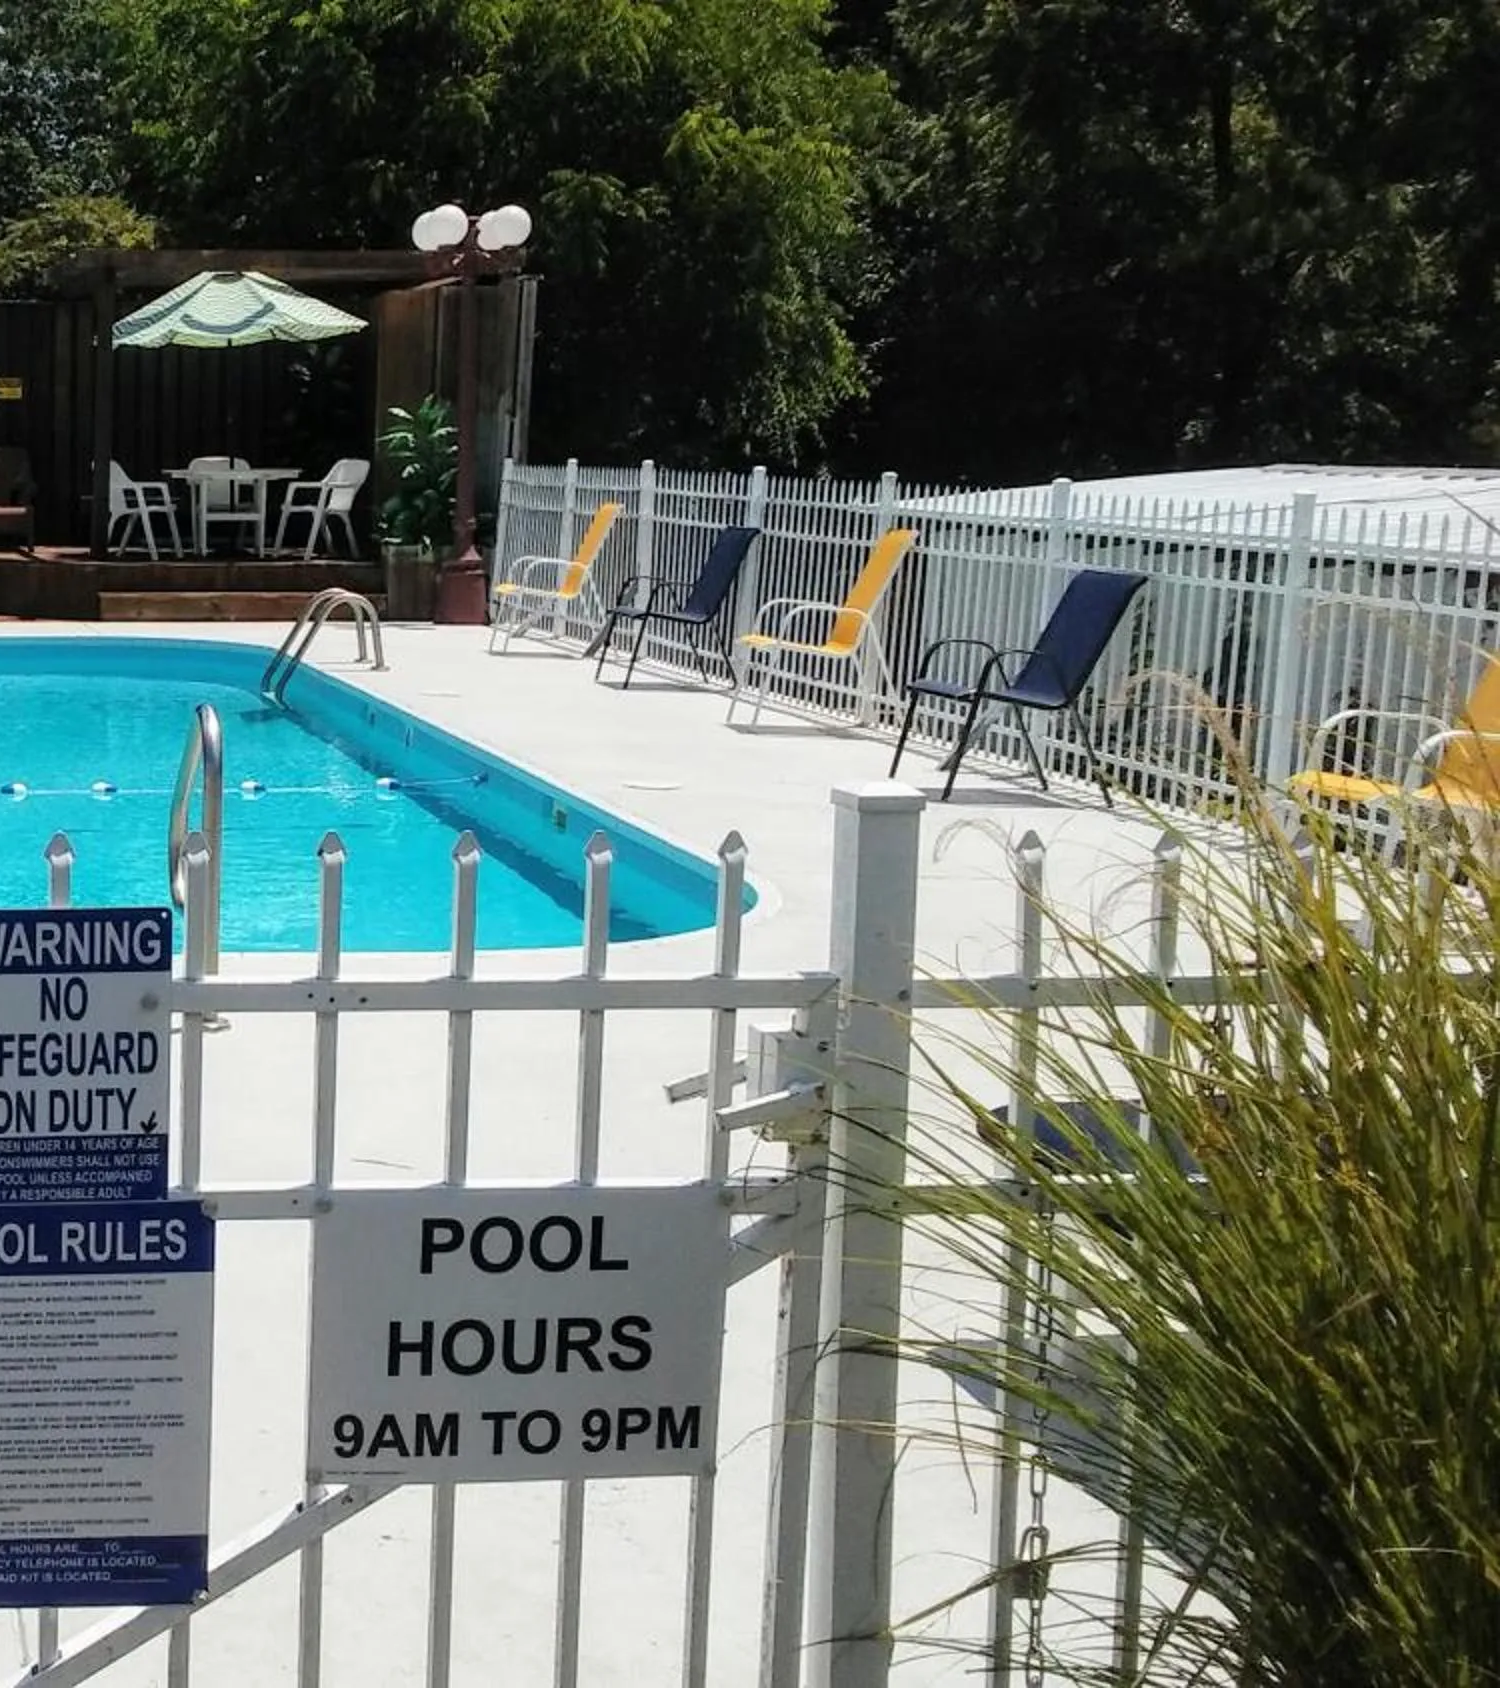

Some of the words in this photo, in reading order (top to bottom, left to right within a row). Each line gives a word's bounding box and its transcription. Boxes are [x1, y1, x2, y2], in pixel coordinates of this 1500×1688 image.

[40, 976, 88, 1022] NO
[49, 1087, 137, 1132] DUTY
[23, 1139, 61, 1152] UNDER
[81, 1138, 118, 1150] YEARS
[120, 1137, 137, 1150] OF
[137, 1136, 160, 1149] AGE
[76, 1153, 111, 1167] SHALL
[113, 1153, 137, 1166] NOT
[139, 1152, 161, 1166] USE
[29, 1170, 73, 1185] UNLESS
[74, 1168, 153, 1184] ACCOMPANIED
[9, 1188, 18, 1200] A
[19, 1186, 95, 1200] RESPONSIBLE
[97, 1185, 133, 1199] ADULT
[61, 1219, 188, 1262] RULES
[419, 1214, 629, 1274] POOL
[387, 1315, 653, 1377] HOURS
[333, 1412, 460, 1458] 9AM
[481, 1409, 562, 1455] TO
[581, 1405, 702, 1452] 9PM
[9, 1543, 52, 1555] HOURS
[103, 1541, 120, 1553] TO
[15, 1557, 84, 1570] TELEPHONE
[86, 1557, 99, 1567] IS
[101, 1555, 157, 1568] LOCATED
[20, 1572, 38, 1583] KIT
[41, 1572, 54, 1583] IS
[55, 1571, 112, 1583] LOCATED
